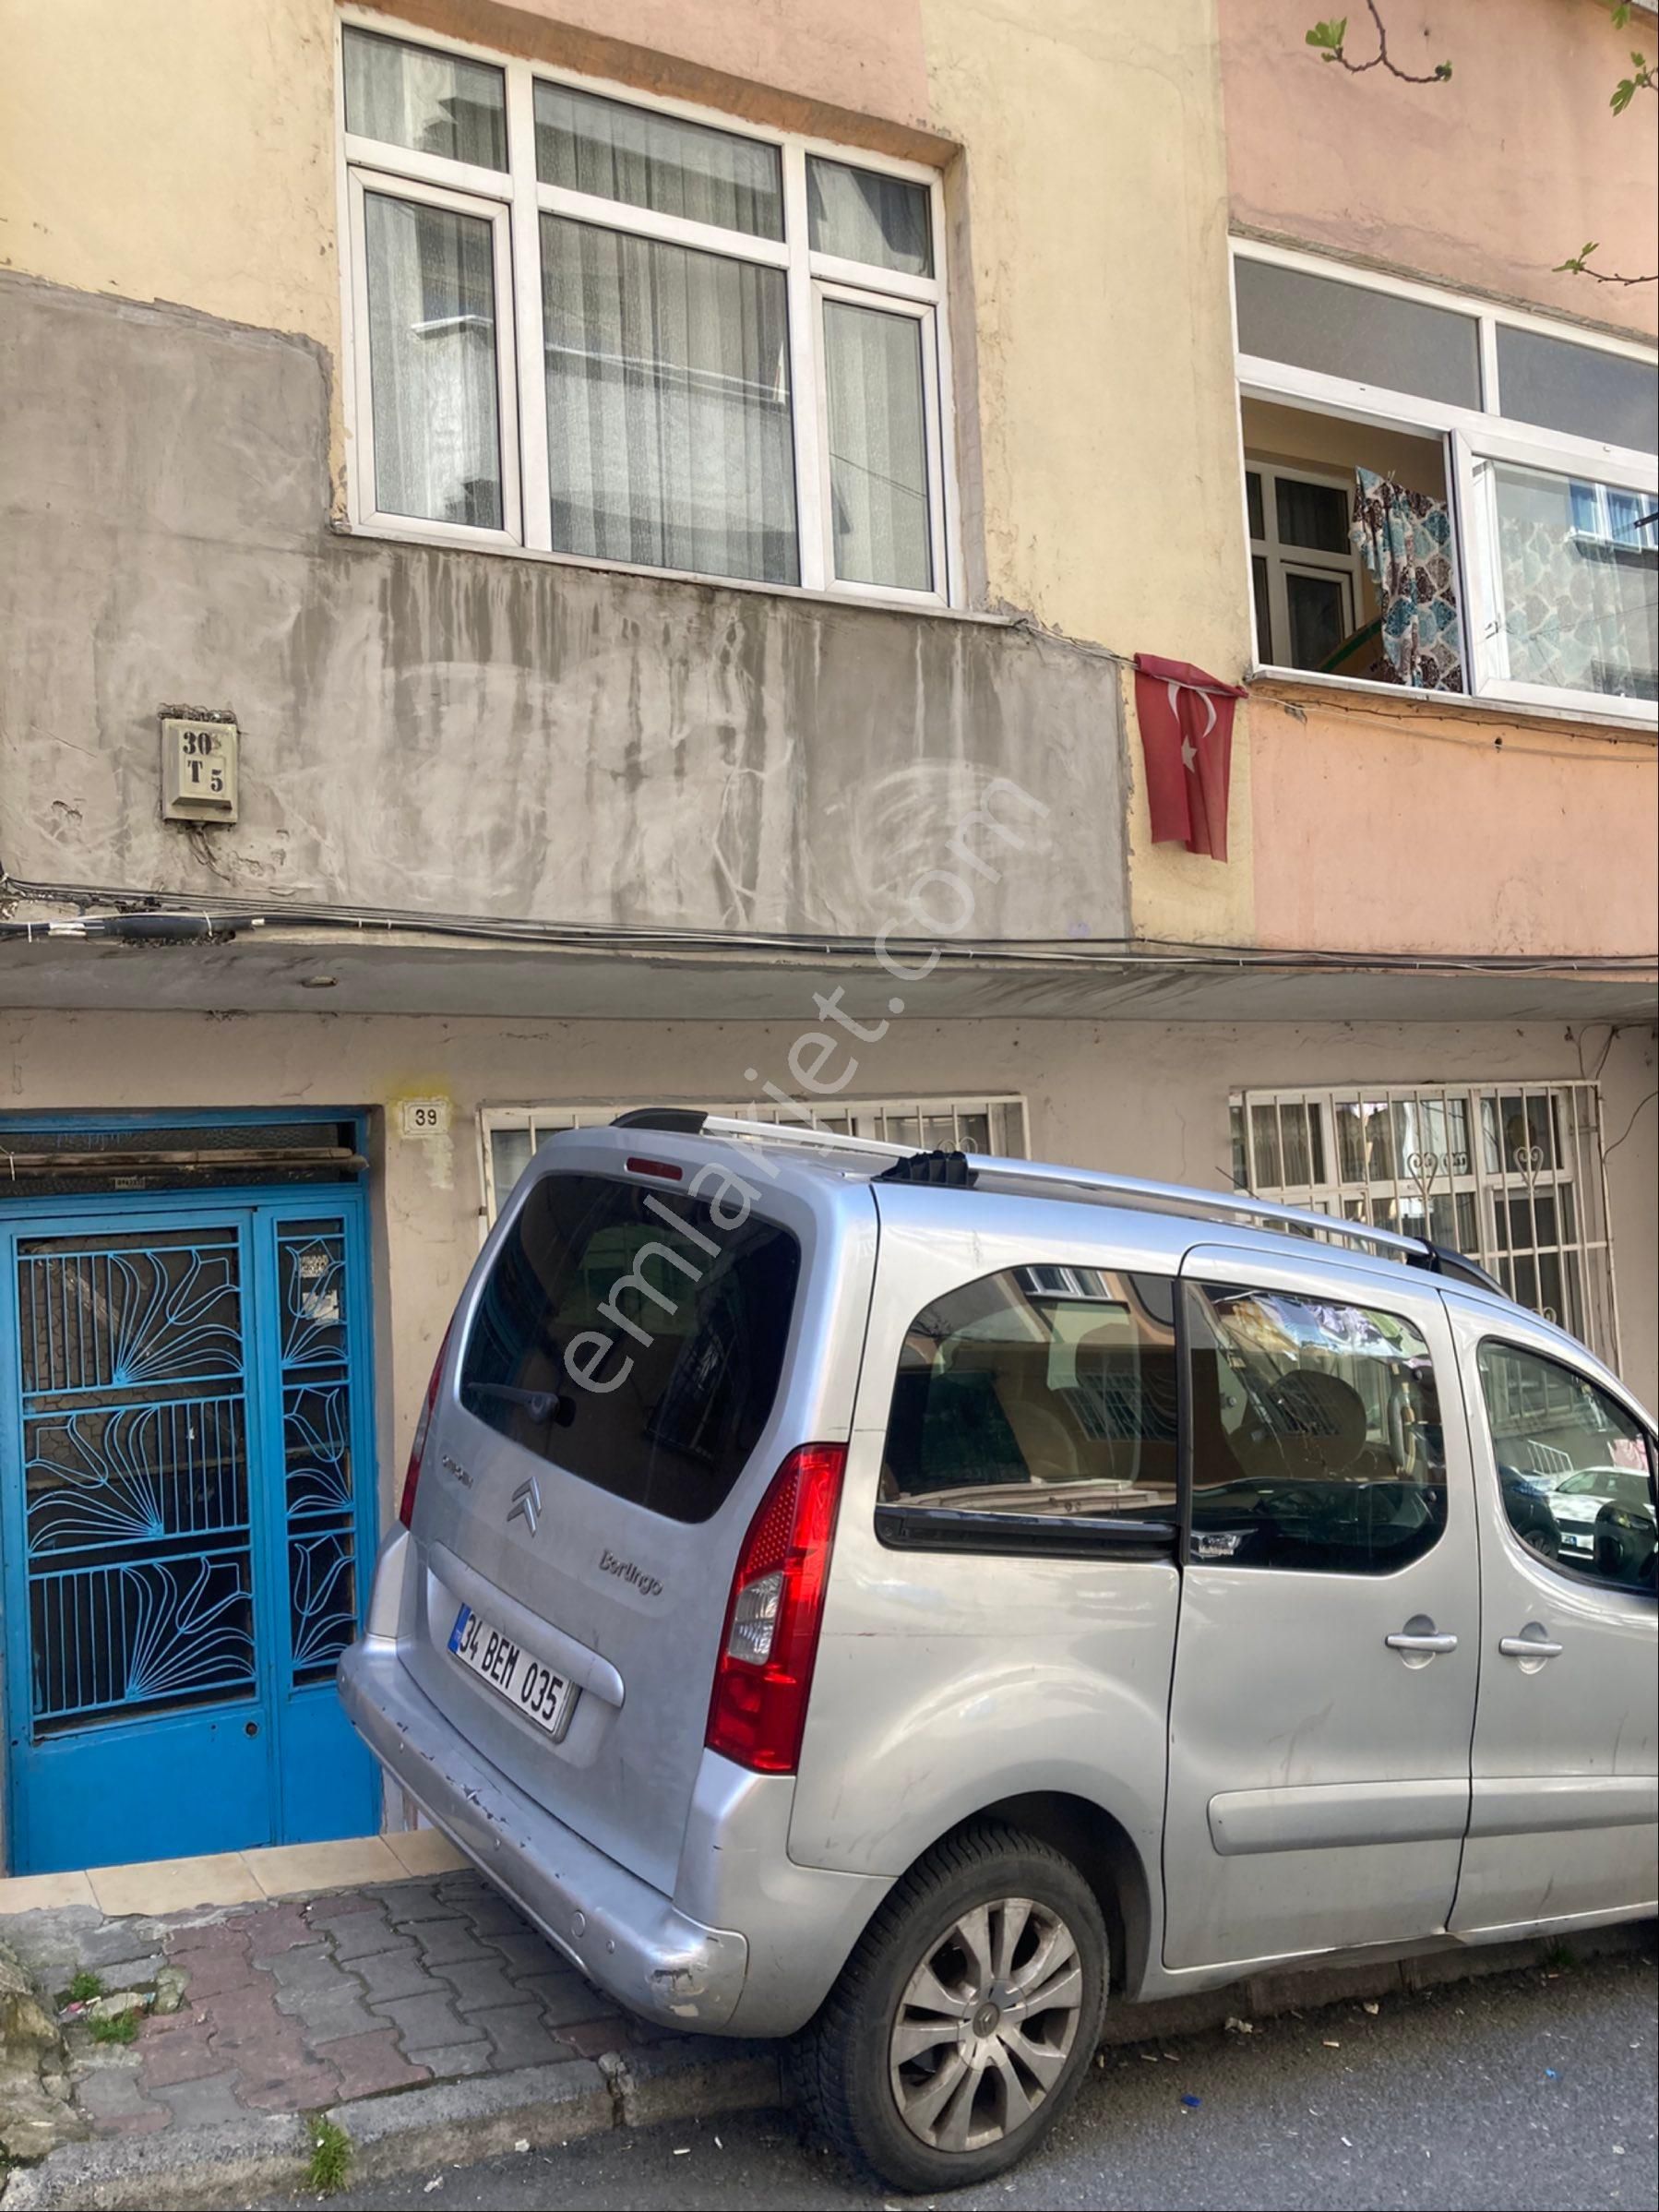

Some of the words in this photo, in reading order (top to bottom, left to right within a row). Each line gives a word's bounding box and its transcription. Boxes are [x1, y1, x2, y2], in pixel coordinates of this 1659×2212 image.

[183, 731, 212, 755] 30
[187, 760, 203, 783] T
[210, 769, 223, 793] 5
[415, 1109, 437, 1126] 39
[598, 1548, 664, 1596] Berlingo
[460, 1613, 483, 1661] 34
[481, 1631, 520, 1690] BEM
[520, 1662, 564, 1721] 035
